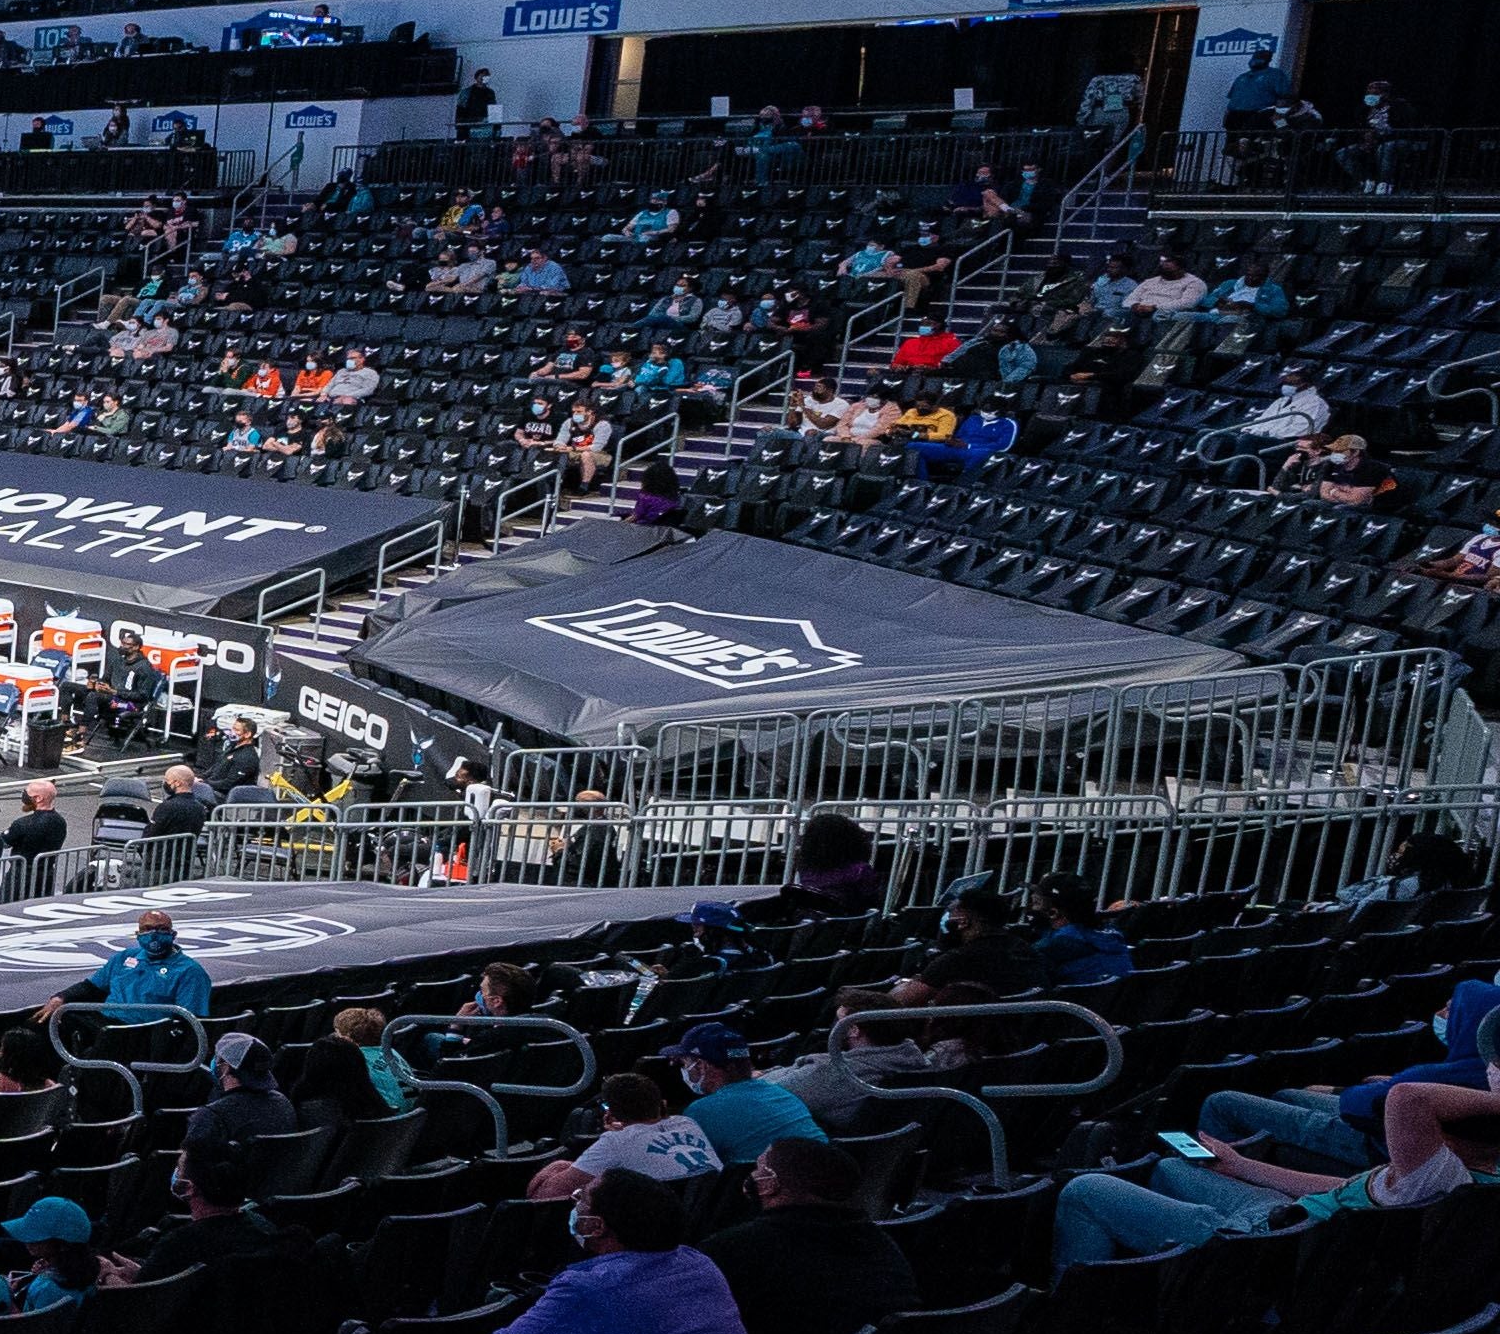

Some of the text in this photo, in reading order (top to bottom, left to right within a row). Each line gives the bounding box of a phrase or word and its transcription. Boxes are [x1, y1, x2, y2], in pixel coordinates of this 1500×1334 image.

[514, 3, 609, 31] LOWE'S
[1202, 37, 1272, 57] LOWE'S
[290, 115, 333, 129] LOWE'S
[591, 609, 800, 679] LOWE'S
[297, 682, 390, 752] GEICO
